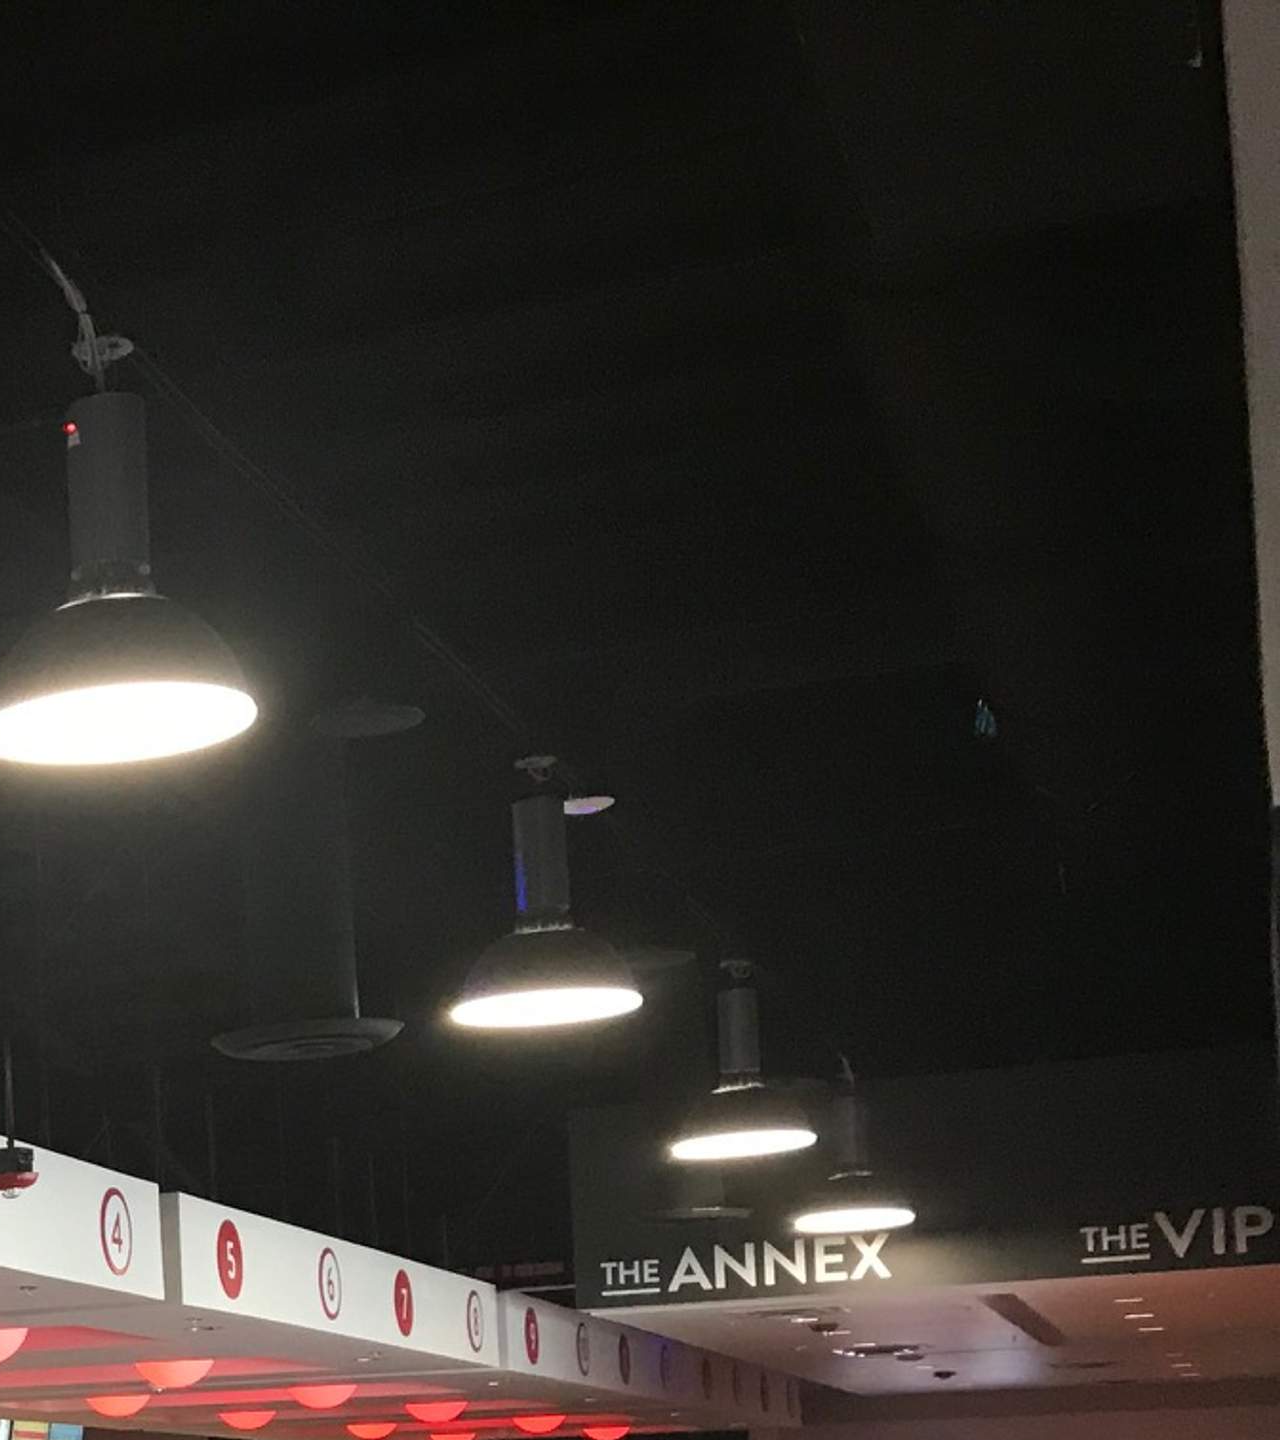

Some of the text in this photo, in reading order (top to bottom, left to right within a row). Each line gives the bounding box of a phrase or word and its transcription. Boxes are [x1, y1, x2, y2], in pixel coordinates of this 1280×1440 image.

[111, 1211, 124, 1254] 4
[1080, 1204, 1276, 1258] THE VIP
[226, 1240, 237, 1280] 5
[600, 1232, 894, 1294] THE ANNEX
